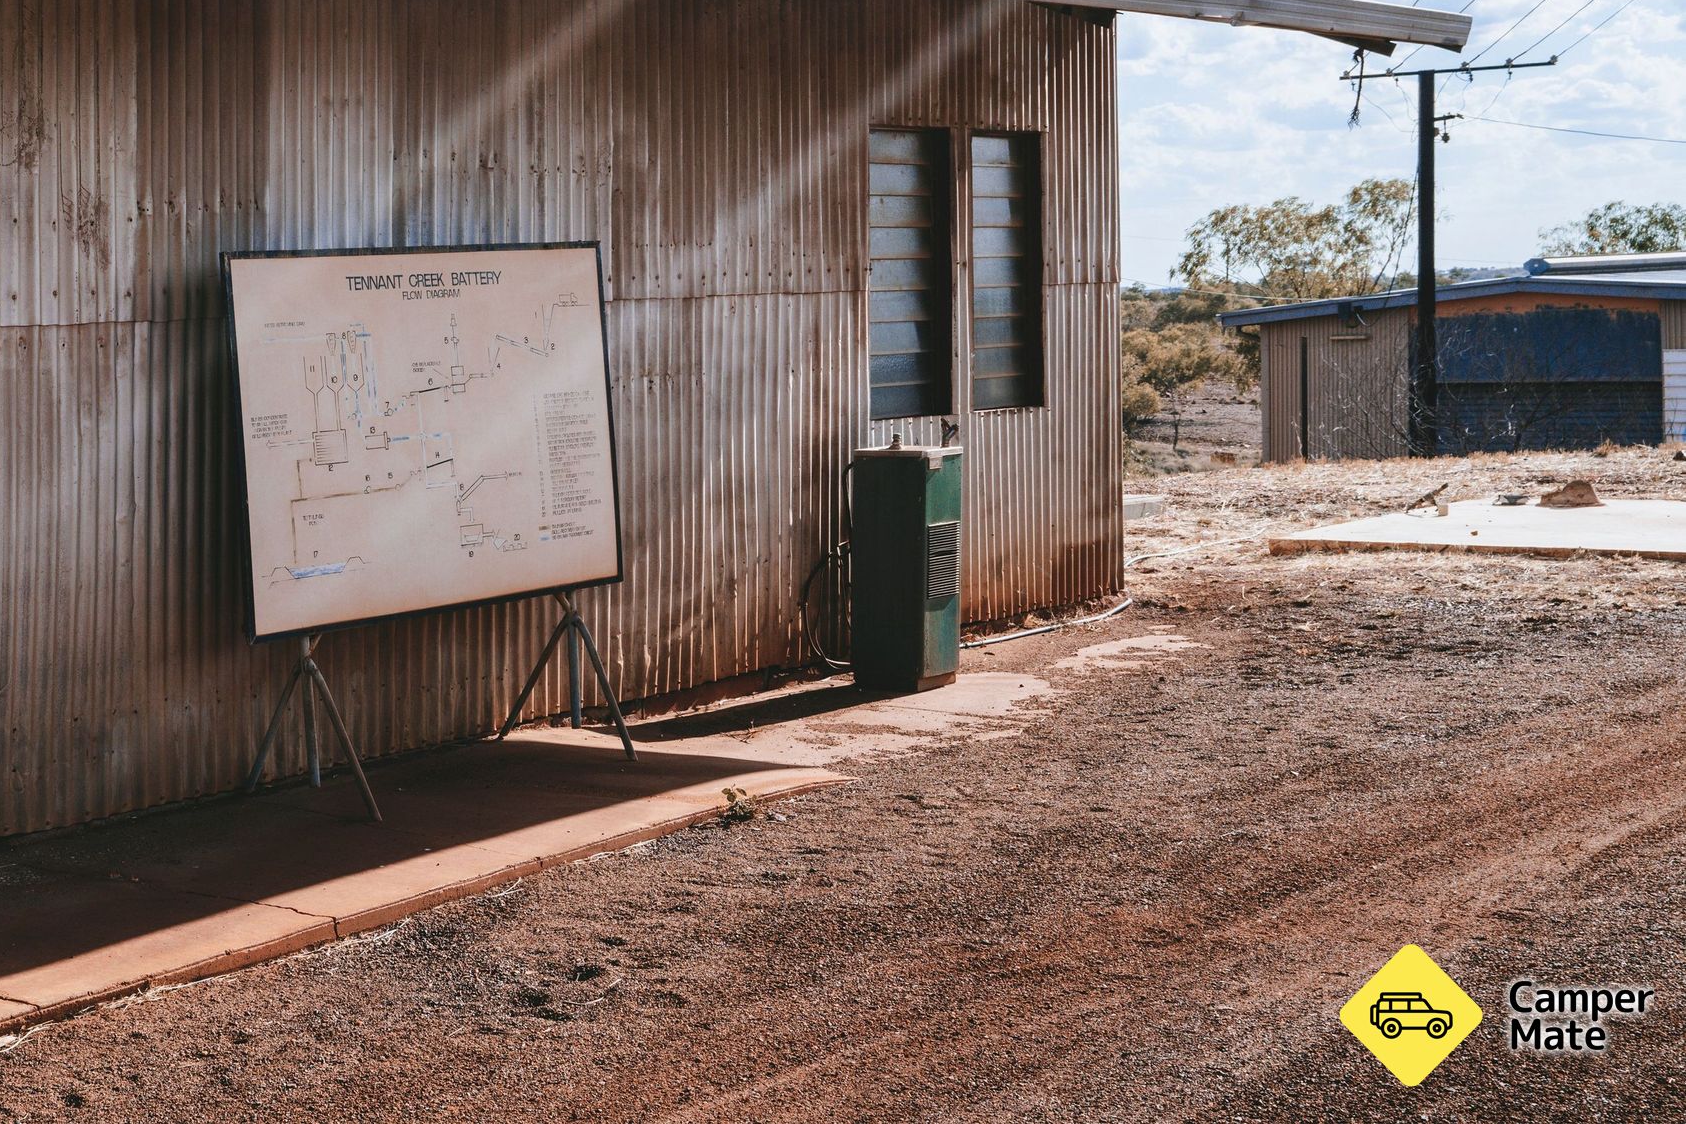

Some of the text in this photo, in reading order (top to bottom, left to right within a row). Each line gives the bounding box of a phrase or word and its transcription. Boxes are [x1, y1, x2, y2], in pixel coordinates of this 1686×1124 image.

[346, 271, 502, 291] TENNANT CREEK BATTERY
[402, 289, 461, 300] FLOW DIAGRAM
[444, 336, 449, 344] 5
[524, 336, 529, 344] 3
[550, 342, 555, 350] 2
[352, 373, 359, 382] 9
[428, 378, 433, 386] 6
[385, 401, 390, 409] 7
